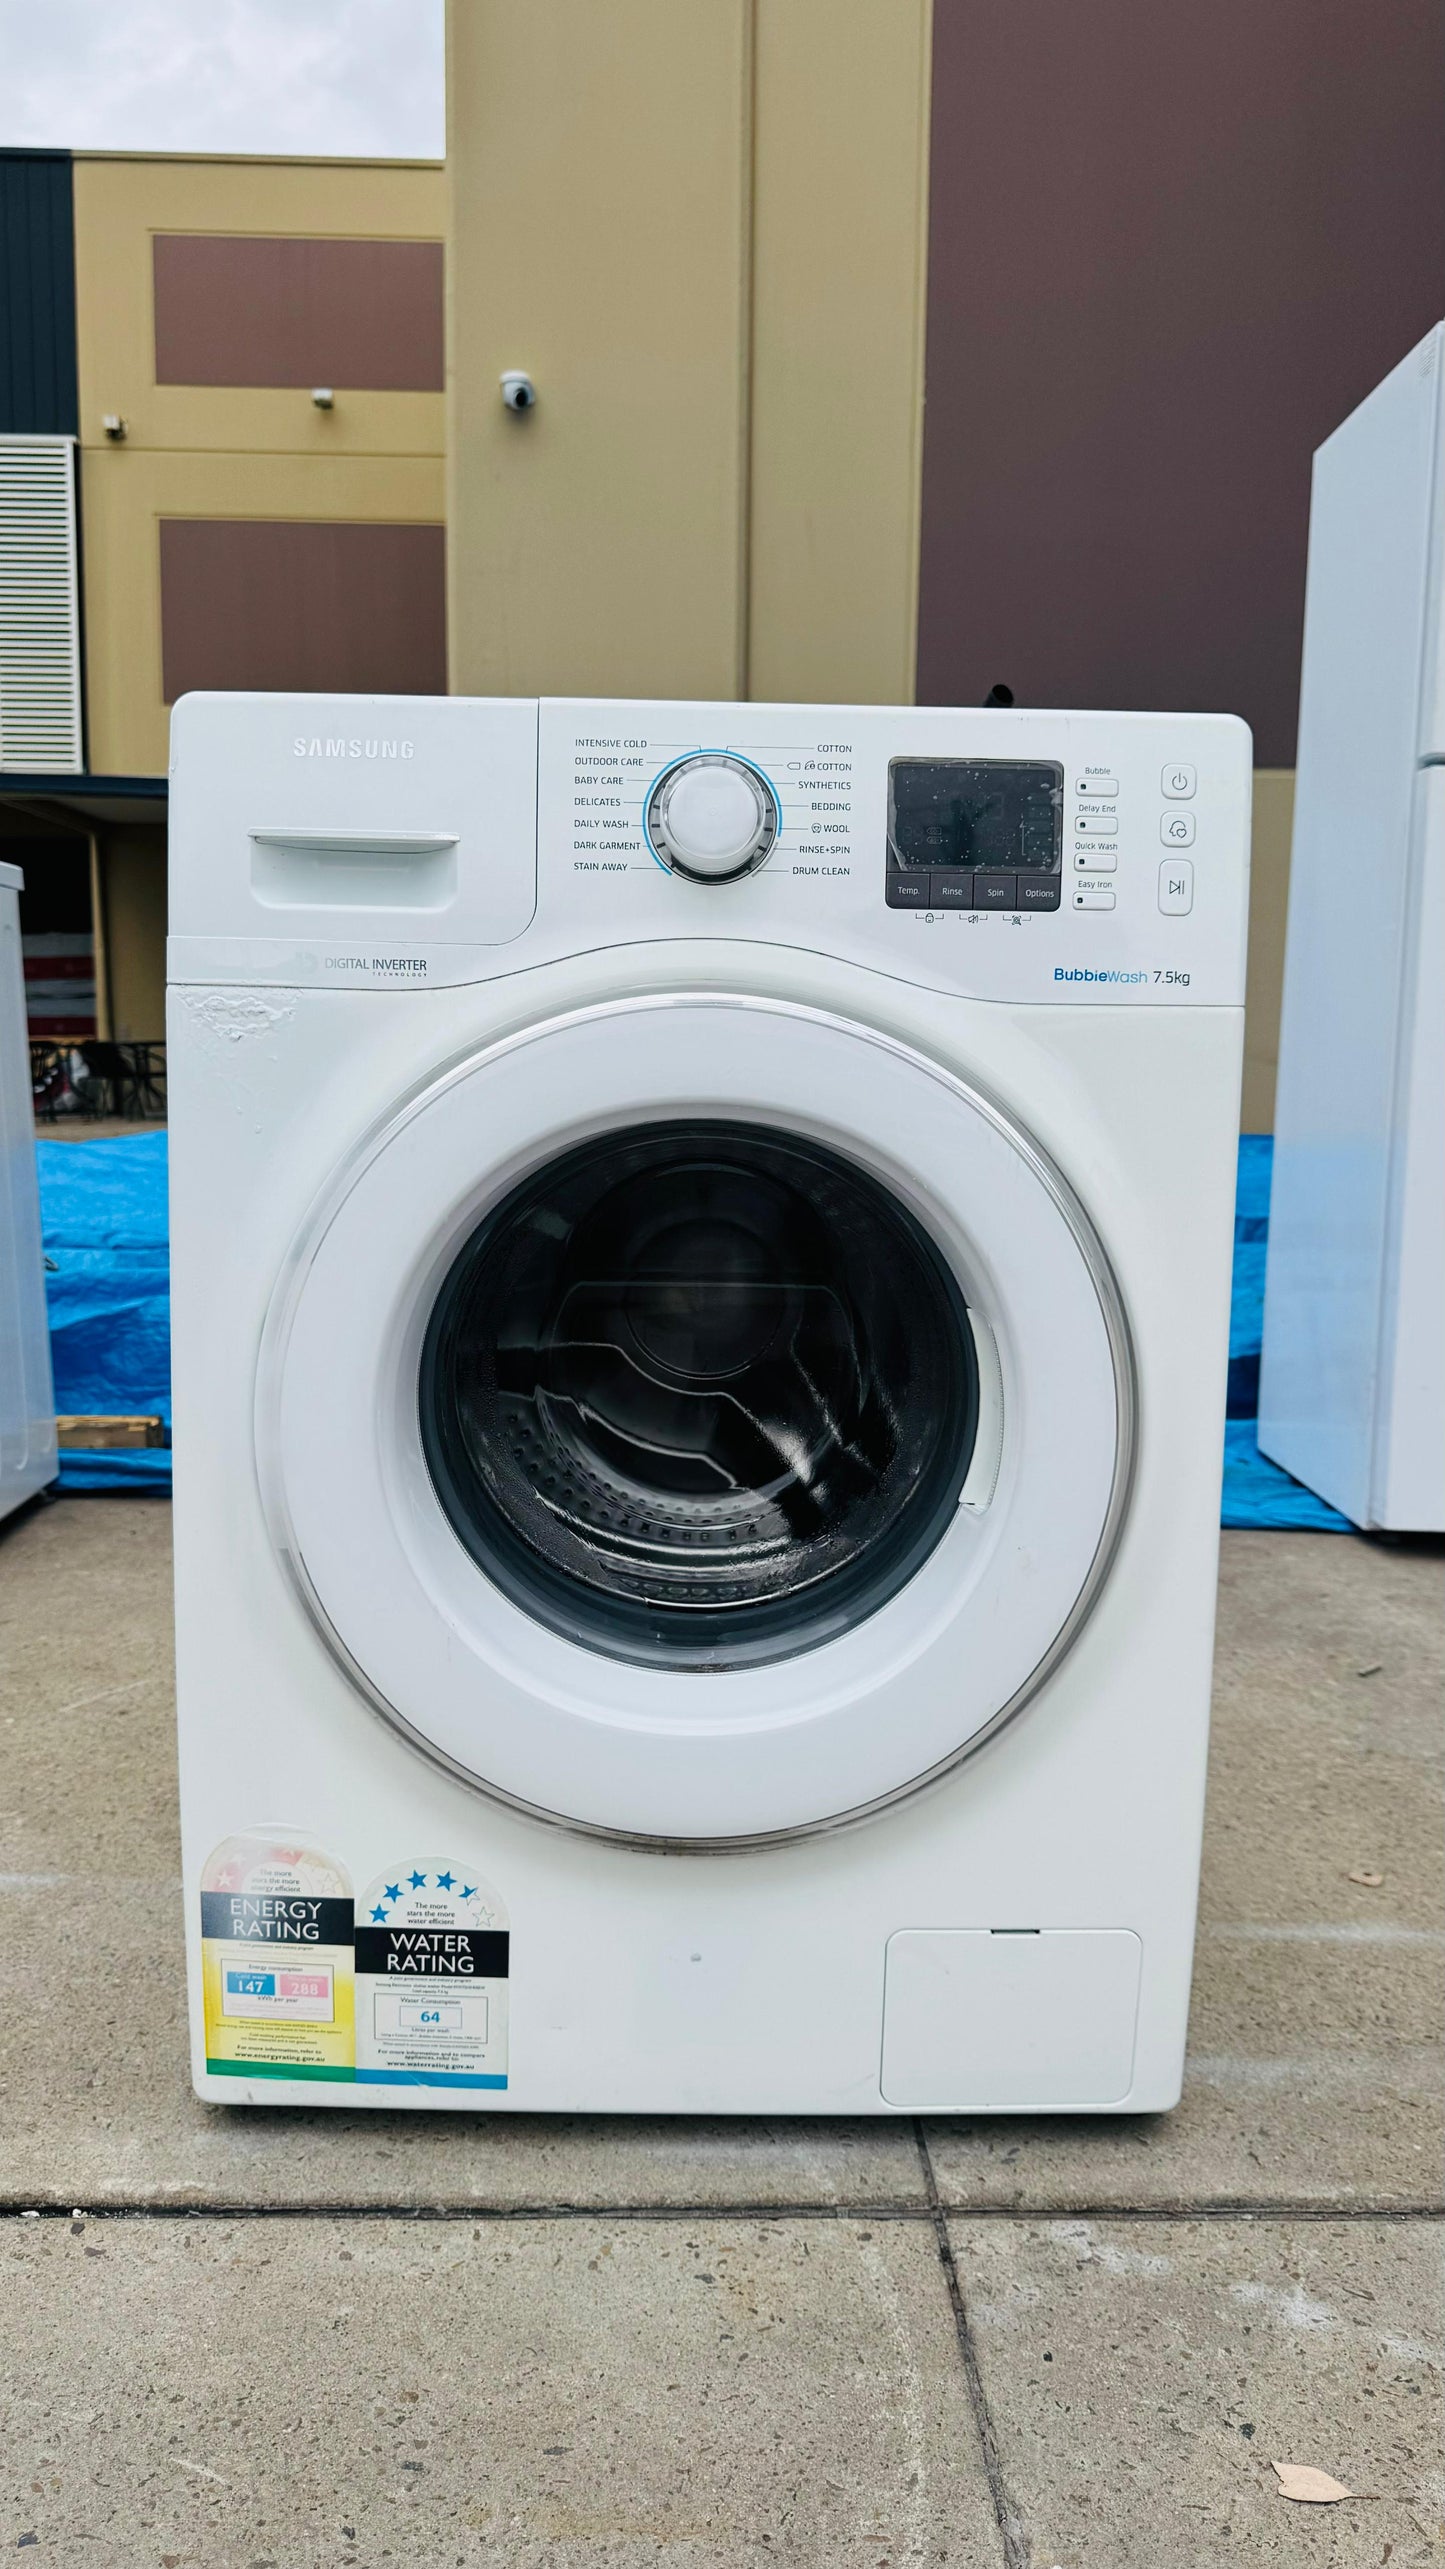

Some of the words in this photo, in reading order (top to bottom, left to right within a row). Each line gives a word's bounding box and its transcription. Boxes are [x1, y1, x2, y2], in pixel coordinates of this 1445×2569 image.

[575, 739, 621, 748] INTENSIVE
[624, 740, 647, 748] COLD
[817, 744, 852, 752] COTTON
[294, 738, 415, 760] SAMSUNG
[574, 757, 618, 766] OUTDOOR
[620, 758, 644, 766] CARE
[817, 762, 852, 771] COTTON
[1085, 767, 1111, 775] Bubble
[574, 776, 598, 784] BABY
[601, 776, 624, 784] CARE
[798, 781, 852, 790] SYNTHETICS
[574, 798, 621, 806] DELICATES
[812, 802, 852, 811] BEDDING
[1078, 804, 1100, 813] Delay
[574, 820, 600, 828] DAILY
[602, 820, 629, 828] WASH
[824, 824, 850, 832] WOOL
[573, 841, 597, 850] DARK
[600, 842, 641, 850] GARMENT
[799, 846, 850, 854] RINSE+SPIN
[1075, 842, 1096, 850] Quick
[1098, 842, 1118, 850] Wash
[573, 862, 600, 870] STAIN
[602, 863, 628, 871] AWAY
[792, 866, 818, 875] DRUM
[821, 867, 850, 876] CLEAN
[1078, 880, 1096, 889] Easy
[898, 886, 920, 896] Temp.
[942, 887, 963, 896] Rinse
[988, 888, 1004, 897] Spin
[1026, 889, 1054, 898] Options
[325, 958, 370, 970] DIGITAL
[372, 959, 427, 971] INVERTER
[1153, 970, 1191, 986] 7.5kg
[230, 1898, 322, 1920] ENERGY
[232, 1919, 320, 1940] RATING
[390, 1932, 472, 1952] WATER
[387, 1954, 474, 1974] RATING
[238, 1980, 264, 1993] 147
[291, 1982, 319, 1996] 288
[420, 2010, 440, 2023] 64
[234, 2052, 326, 2062] www.energyrating.gov.au
[387, 2060, 474, 2070] www.waterrating.gov.au
